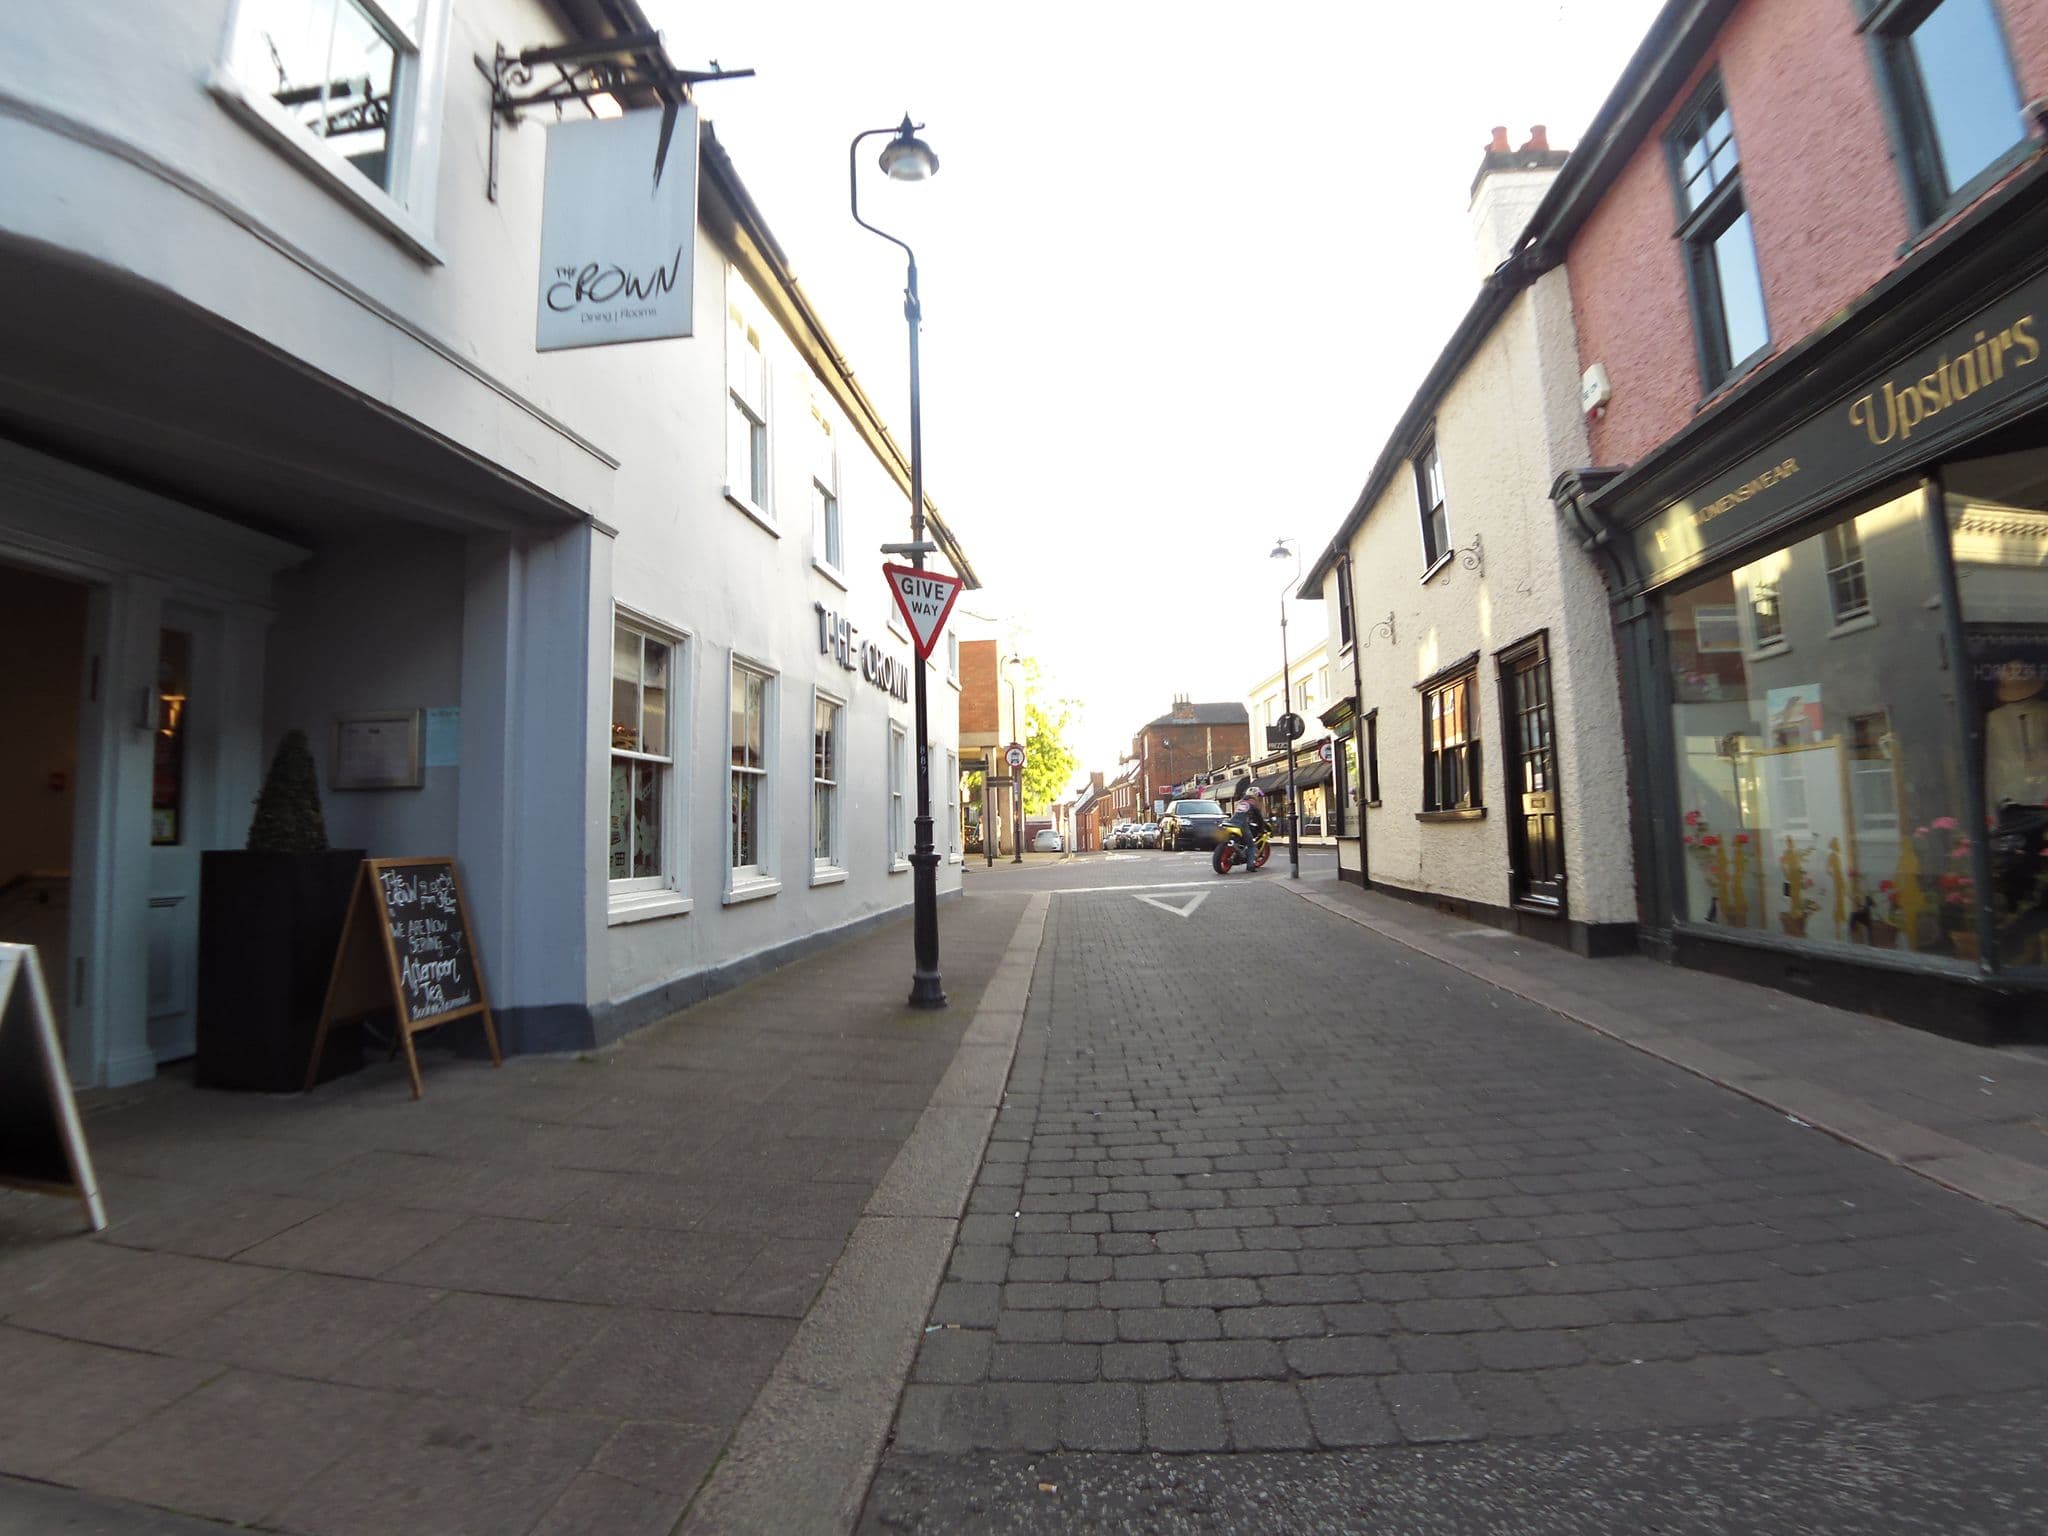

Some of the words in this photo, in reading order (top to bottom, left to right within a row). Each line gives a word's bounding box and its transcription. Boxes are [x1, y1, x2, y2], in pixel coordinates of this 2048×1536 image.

[547, 245, 682, 312] CROWN
[1848, 315, 2040, 445] Upstairs
[901, 577, 945, 601] GIVE
[911, 600, 938, 617] WAY
[814, 600, 858, 671] THE
[861, 639, 908, 703] CROWN
